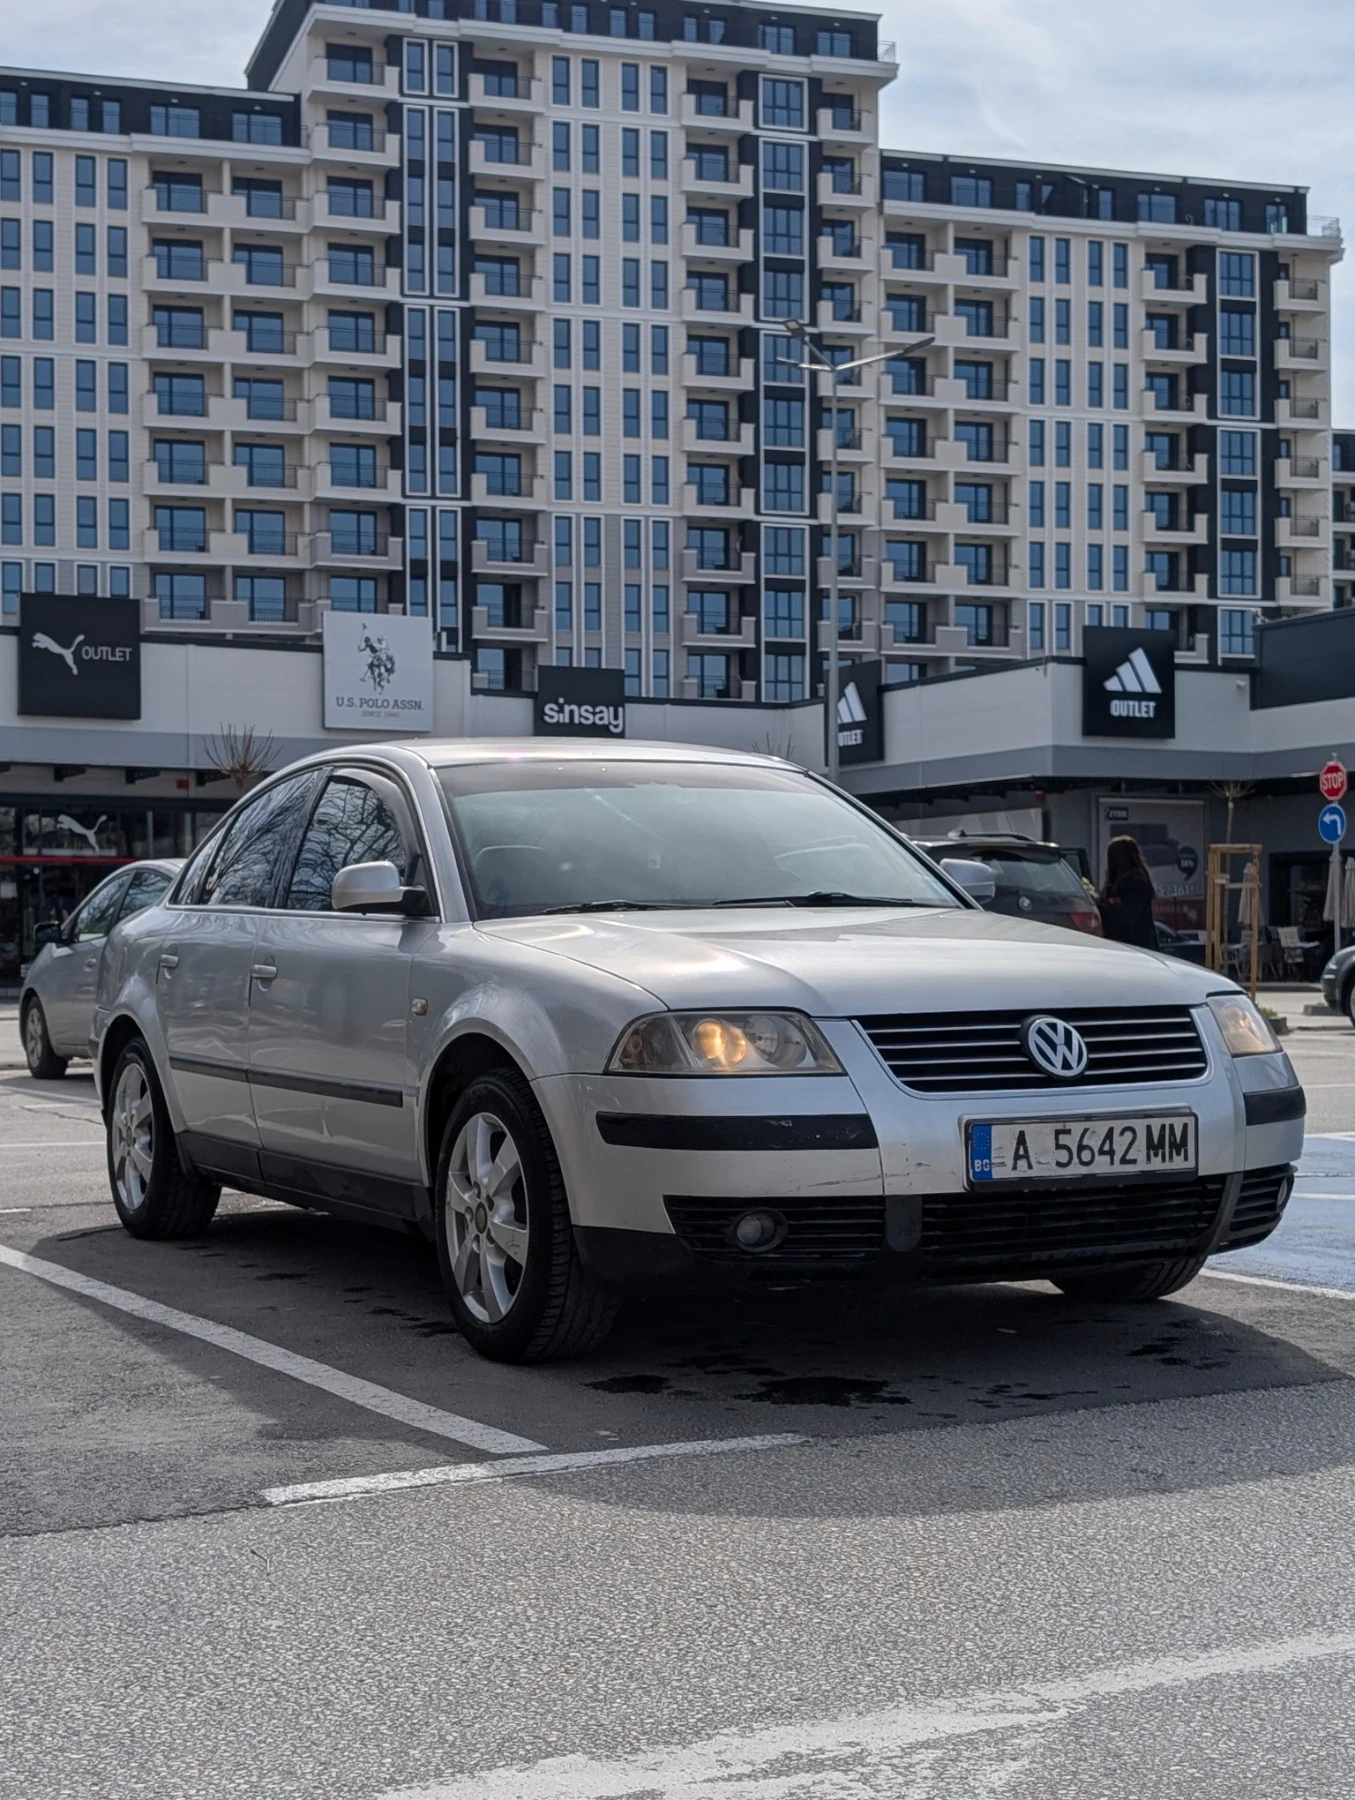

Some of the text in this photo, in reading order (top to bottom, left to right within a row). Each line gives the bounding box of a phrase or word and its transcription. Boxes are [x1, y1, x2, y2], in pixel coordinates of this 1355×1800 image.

[81, 645, 133, 661] OUTLET
[336, 696, 425, 711] U.S. POLO ASSN.
[1110, 699, 1156, 718] OUTLET
[543, 697, 624, 733] sinsay
[838, 729, 864, 747] UTLET
[1322, 771, 1344, 790] STOP
[1011, 1122, 1189, 1171] A 5642 MM
[974, 1159, 991, 1172] BG
